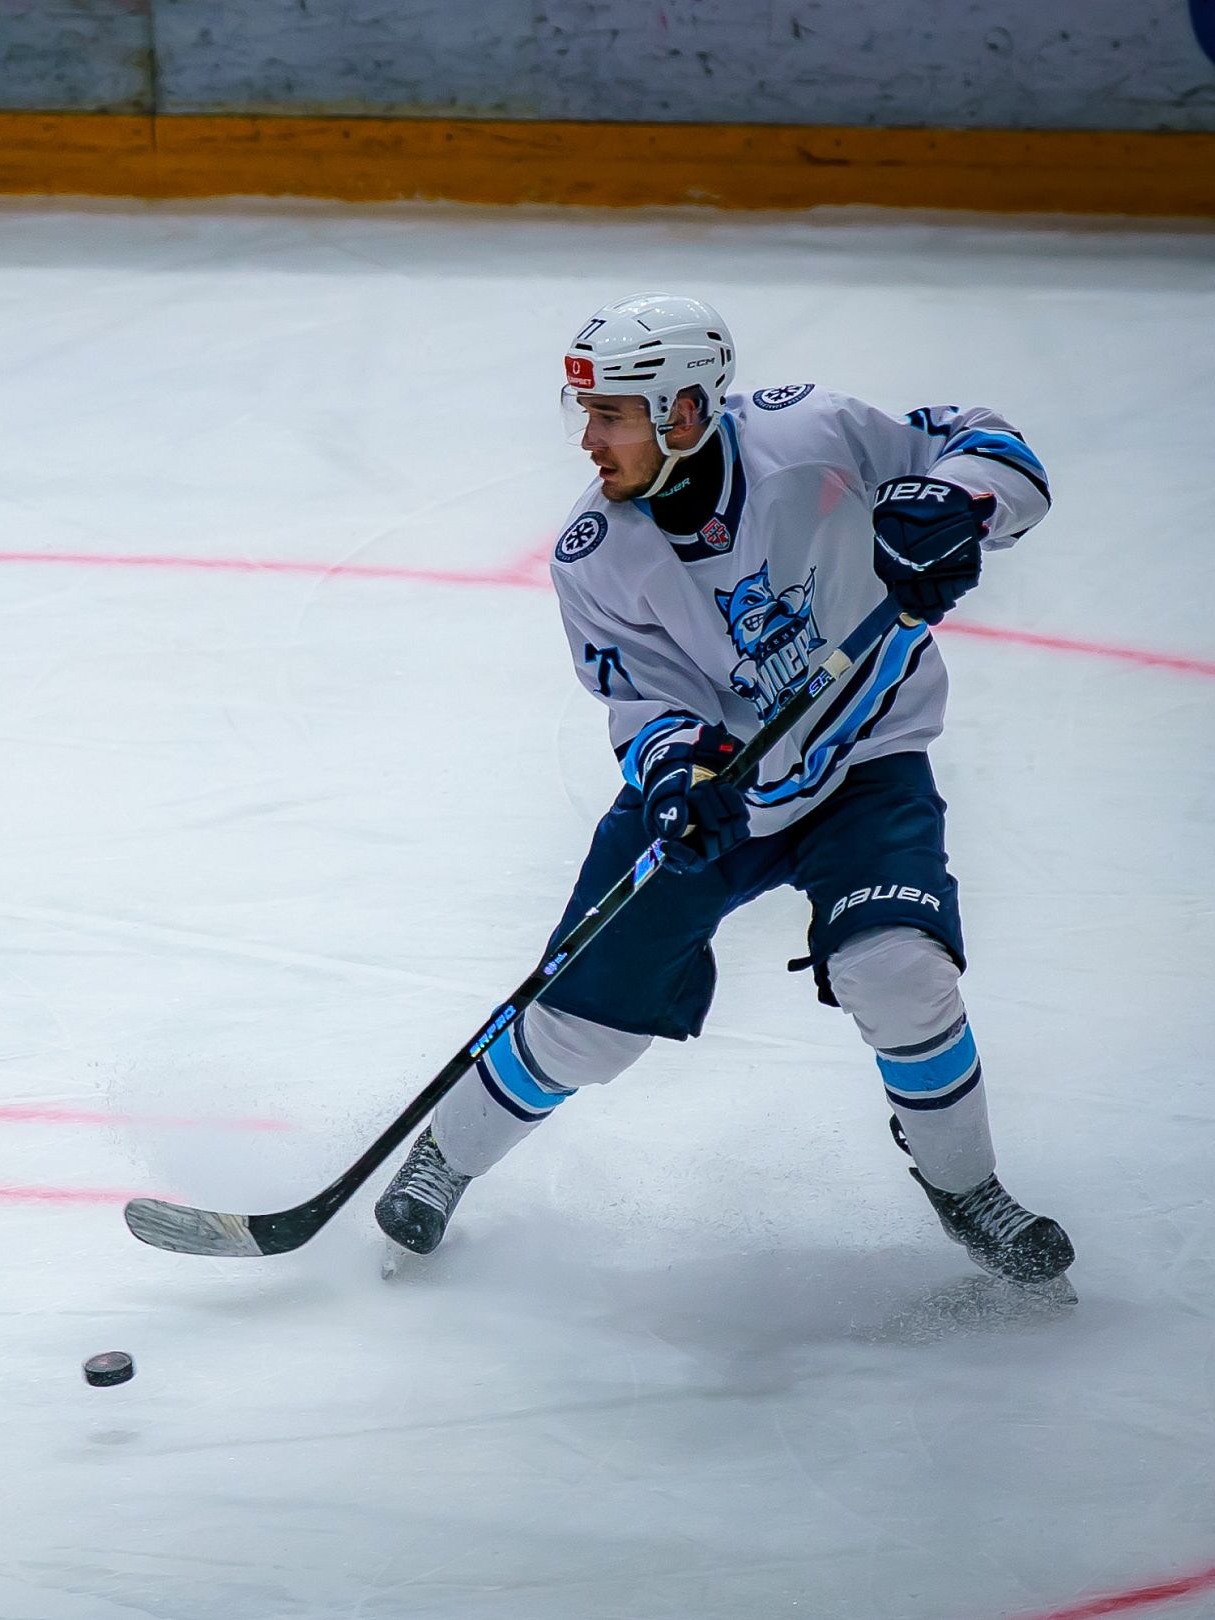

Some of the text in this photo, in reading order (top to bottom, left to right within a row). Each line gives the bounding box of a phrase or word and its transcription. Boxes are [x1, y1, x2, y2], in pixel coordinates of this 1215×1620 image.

[577, 318, 607, 340] 77
[687, 357, 716, 369] CCM
[828, 885, 940, 925] BAUER
